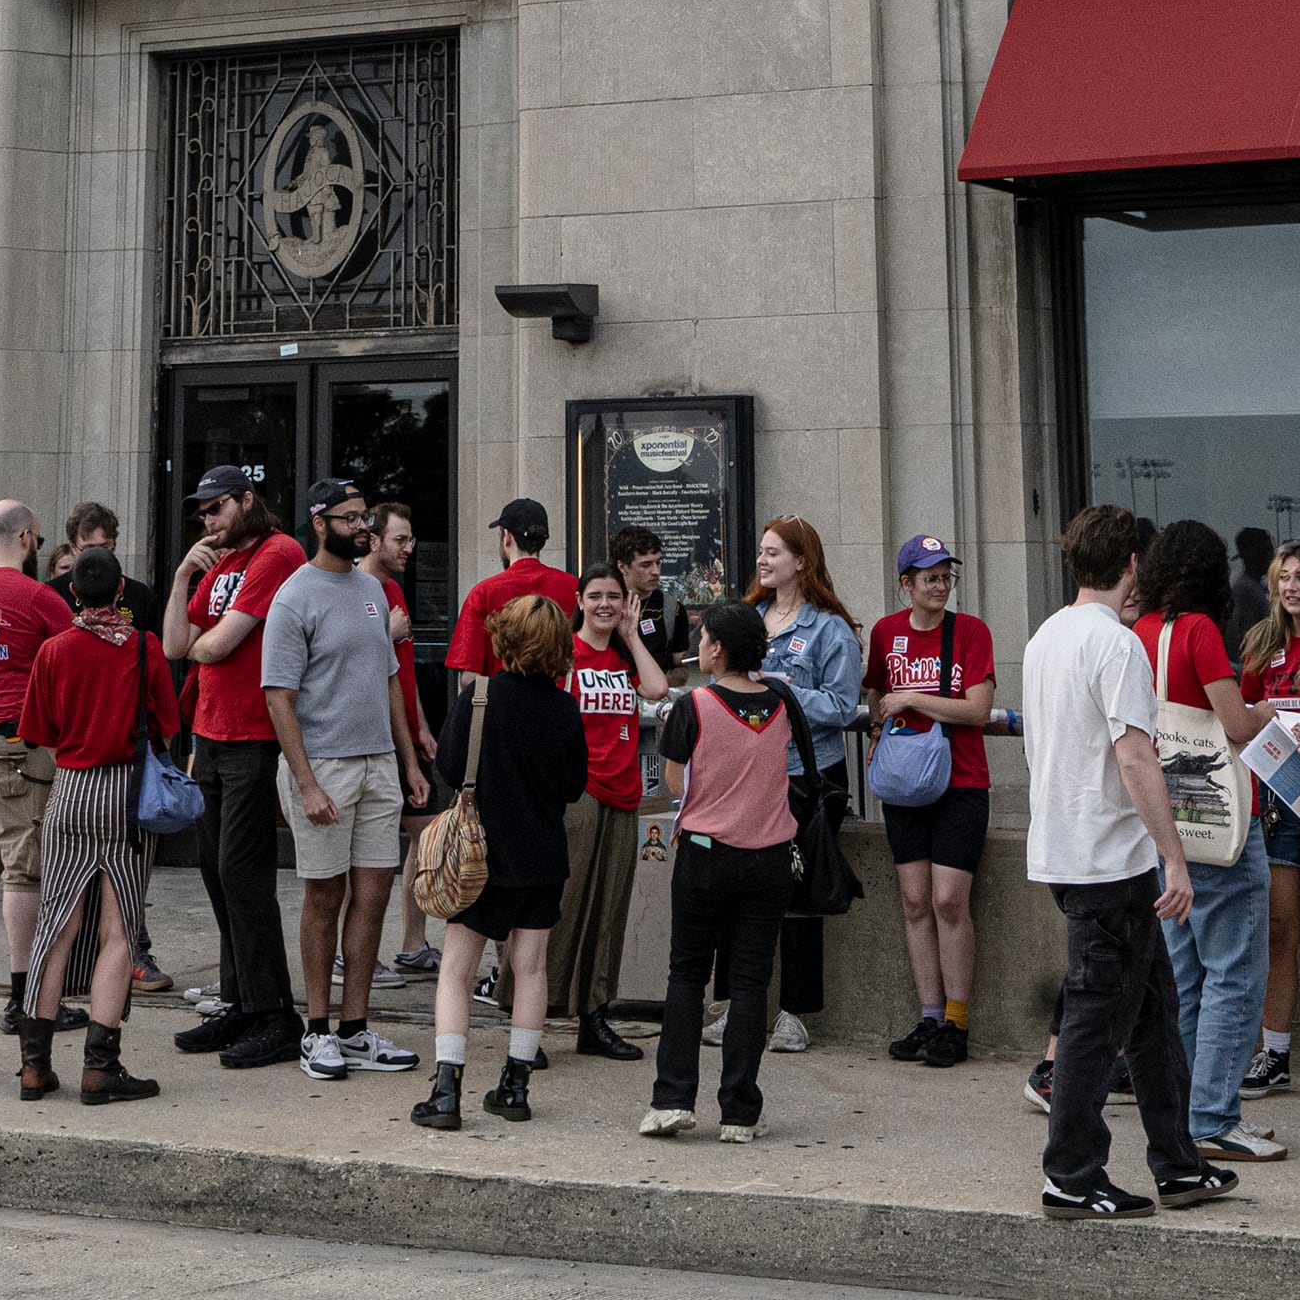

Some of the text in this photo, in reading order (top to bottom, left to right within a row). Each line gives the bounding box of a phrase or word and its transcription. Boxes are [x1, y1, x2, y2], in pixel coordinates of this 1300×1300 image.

[641, 439, 687, 450] xponential
[640, 449, 687, 458] musicfestival
[886, 652, 963, 692] Phillis
[584, 692, 635, 712] HERE!
[1155, 728, 1217, 749] books. cats.
[1178, 828, 1215, 840] sweet.
